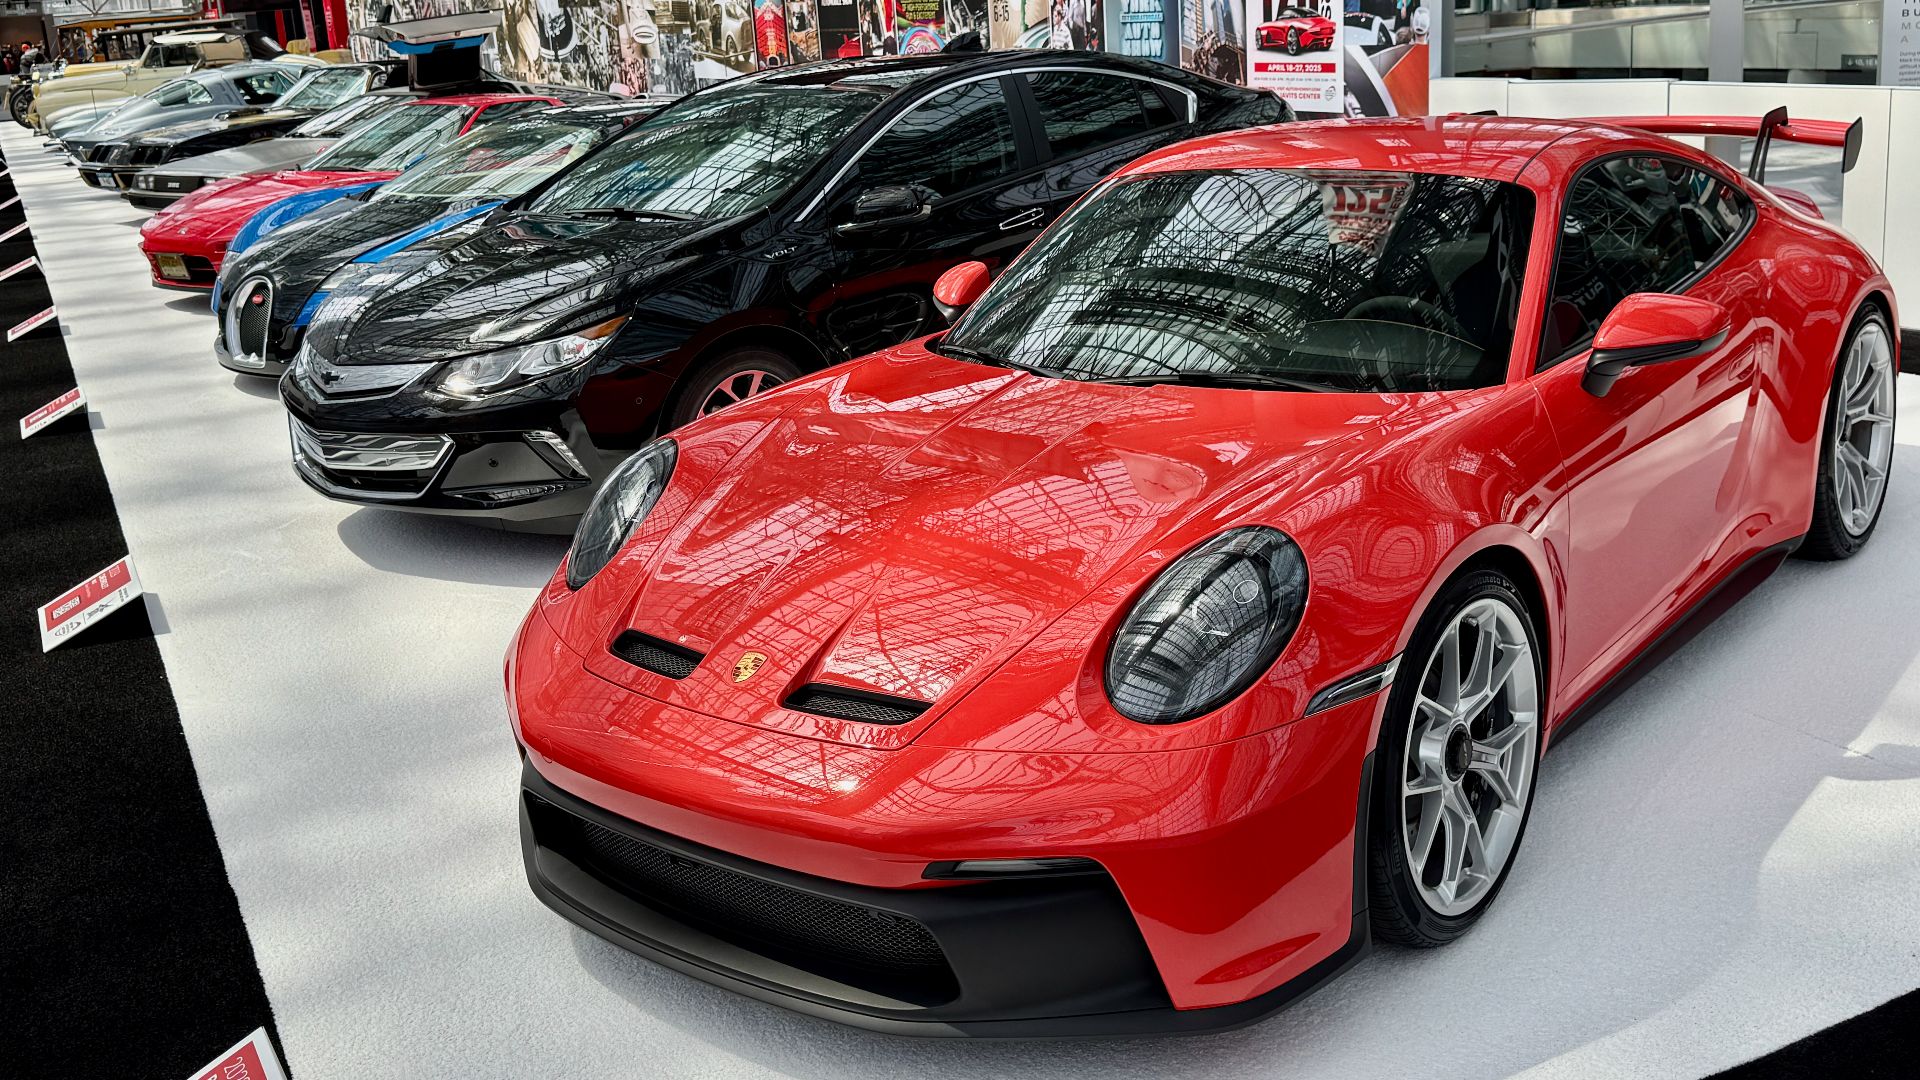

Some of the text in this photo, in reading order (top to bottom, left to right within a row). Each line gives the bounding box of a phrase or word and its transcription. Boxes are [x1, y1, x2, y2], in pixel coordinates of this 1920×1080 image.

[1124, 22, 1160, 39] AUTO
[1267, 64, 1285, 72] APRIL
[1305, 64, 1322, 72] 2025
[764, 246, 798, 259] VOLT
